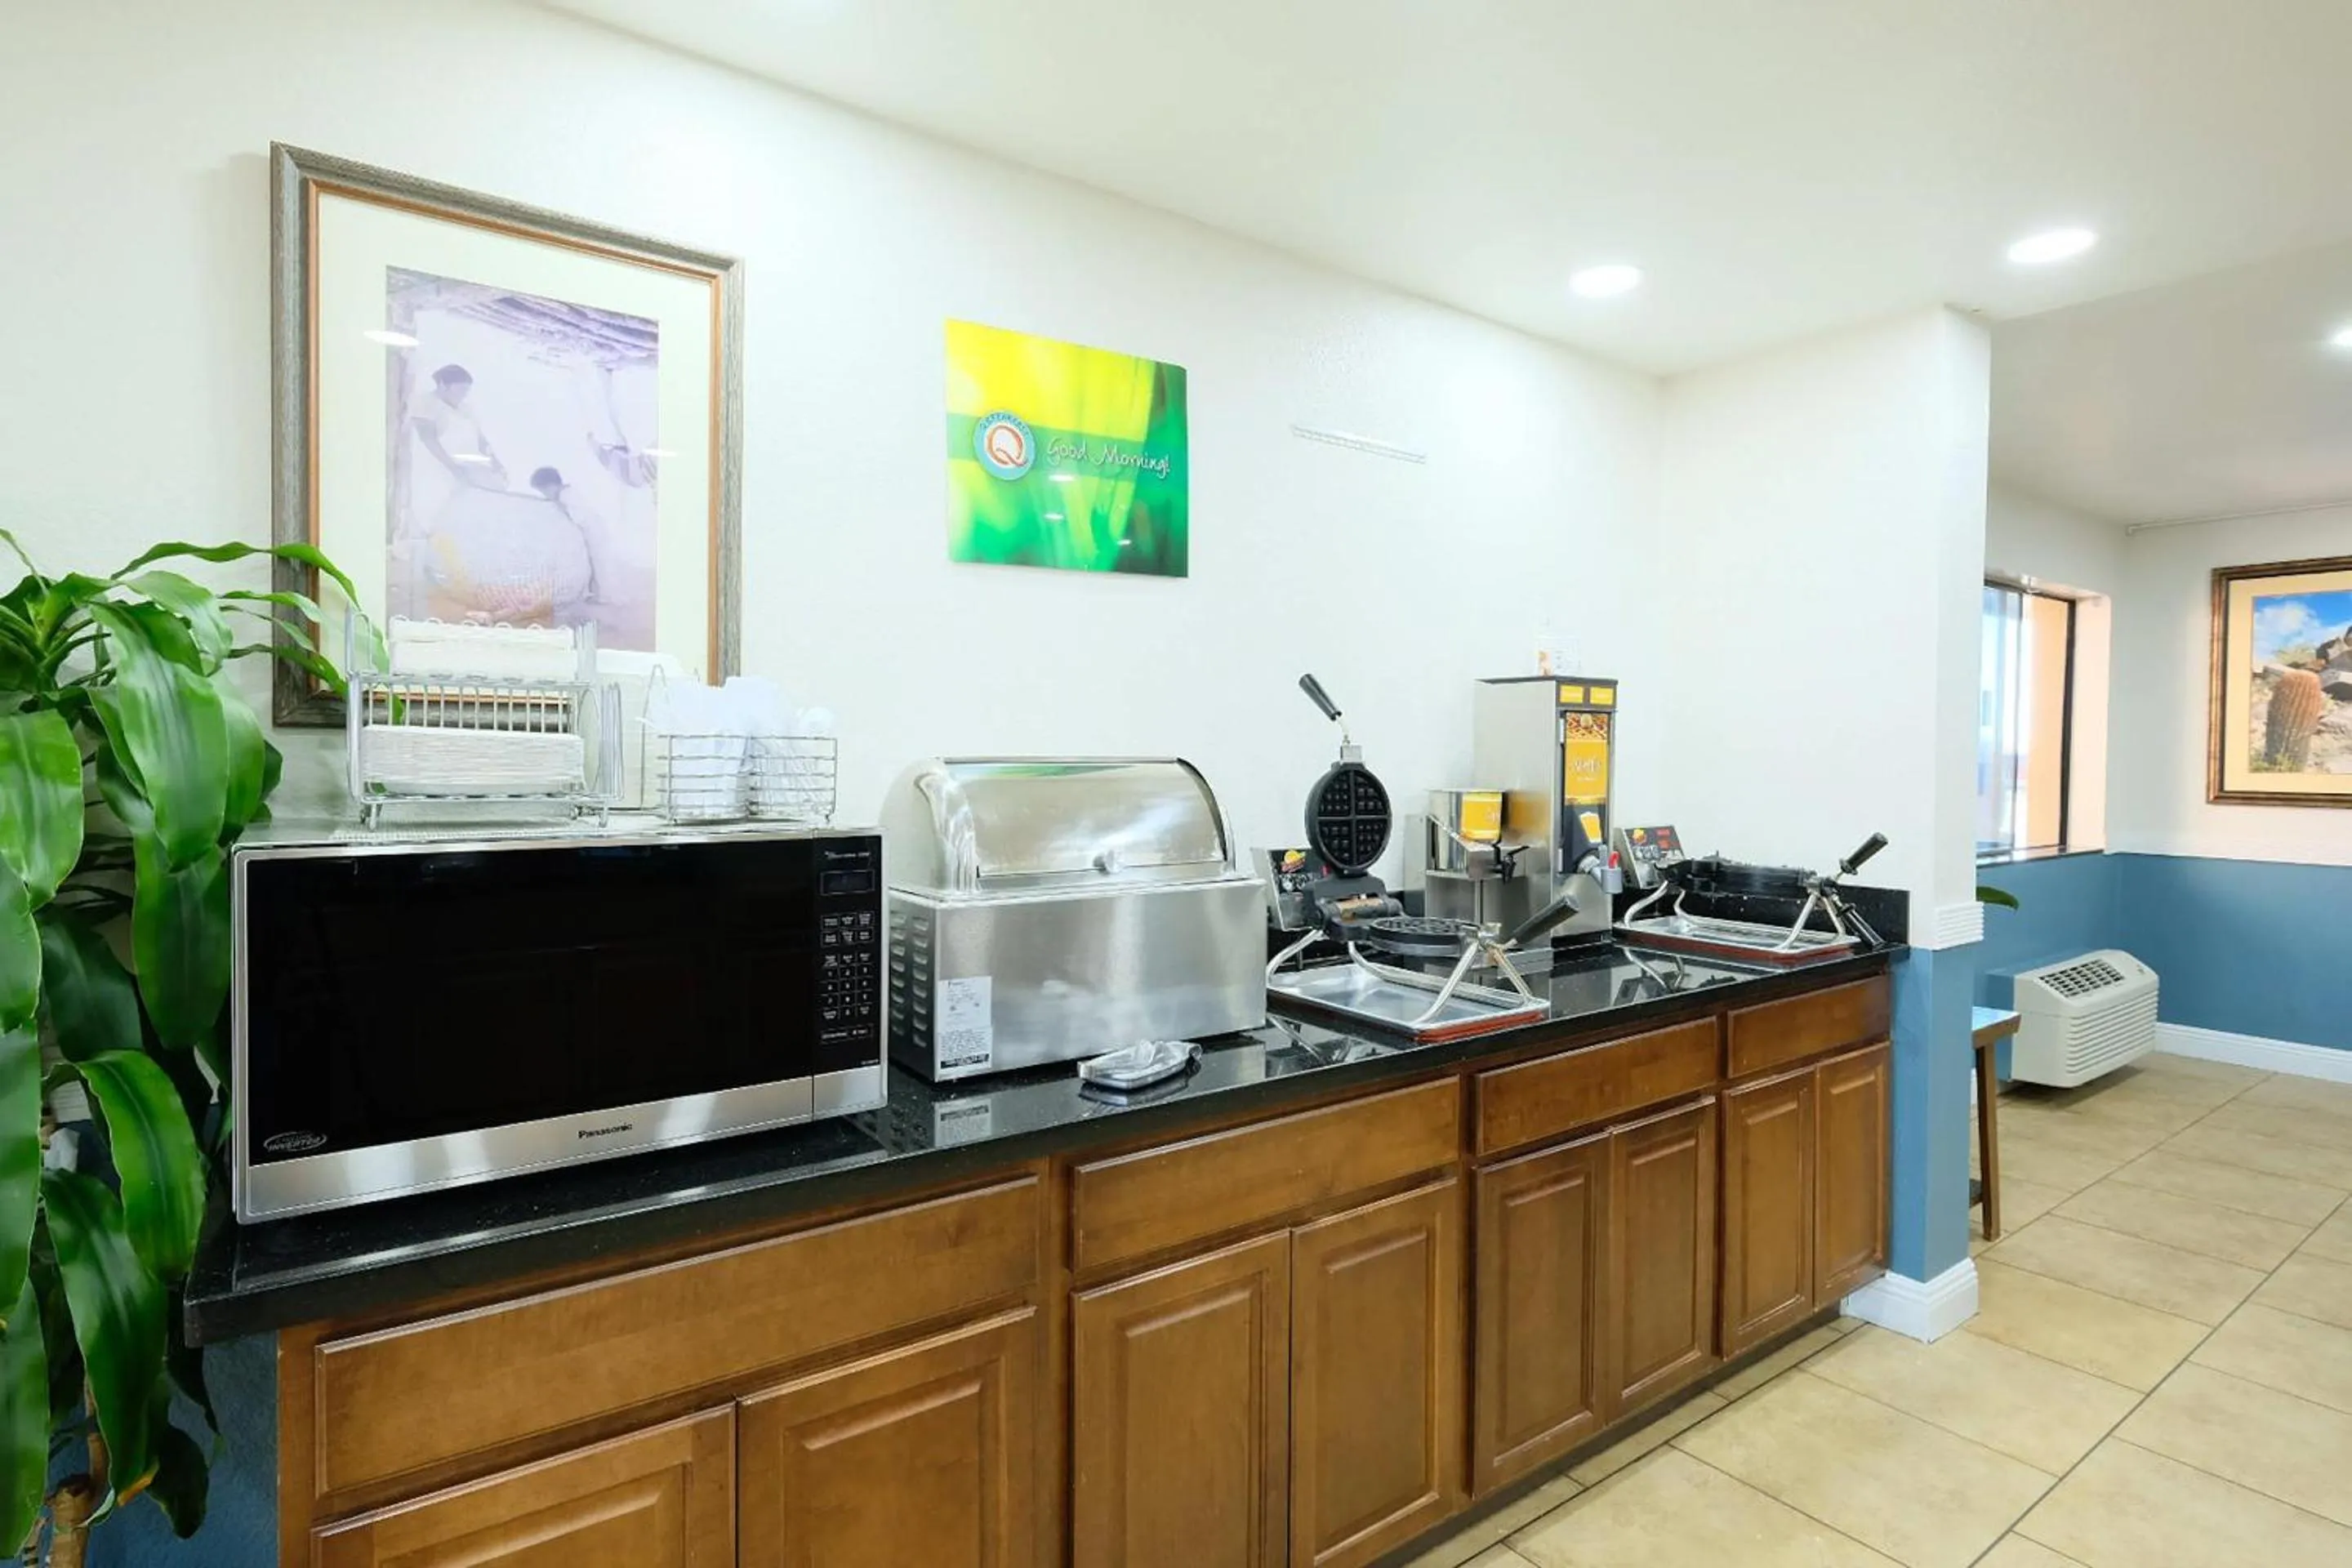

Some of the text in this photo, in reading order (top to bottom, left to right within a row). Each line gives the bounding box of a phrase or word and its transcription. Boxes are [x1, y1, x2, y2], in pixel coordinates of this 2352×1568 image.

[987, 424, 1029, 467] Q
[1046, 436, 1170, 479] Good Morning!
[578, 1122, 633, 1139] Panasonic
